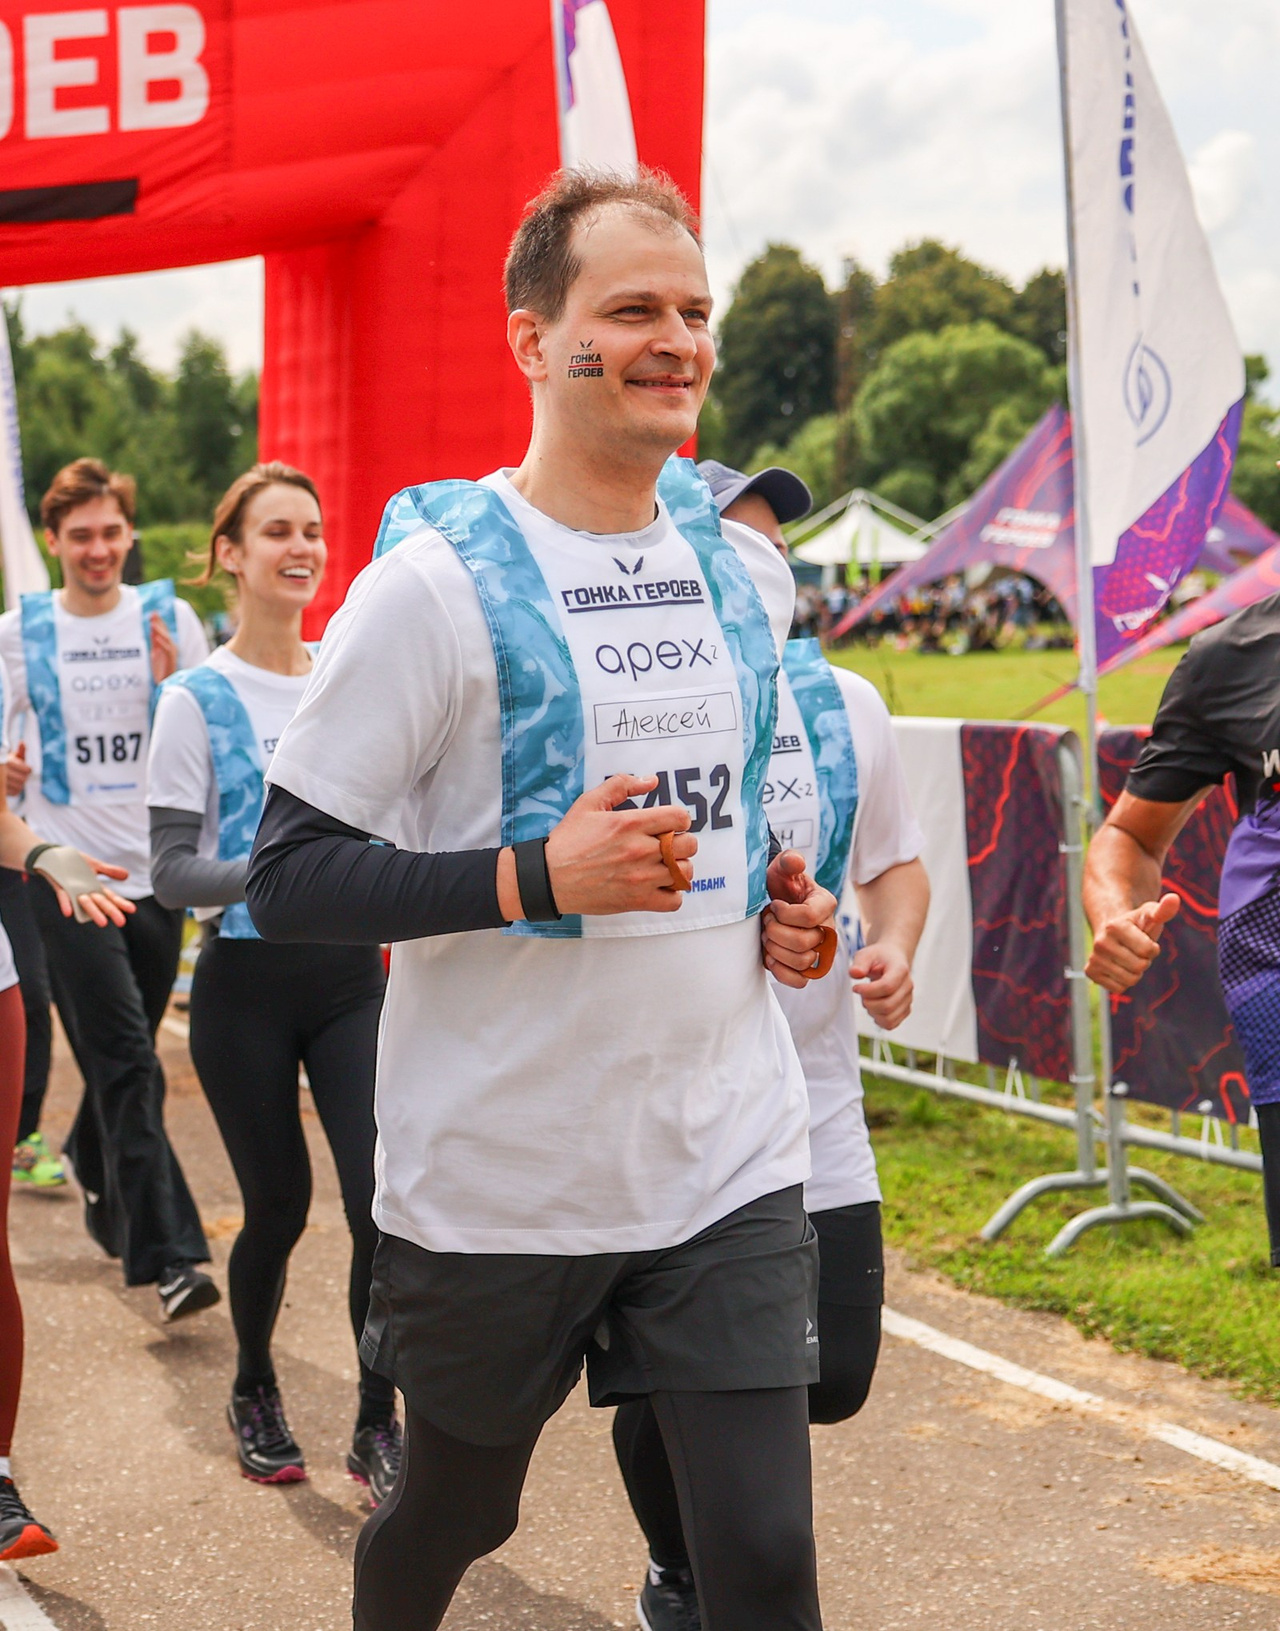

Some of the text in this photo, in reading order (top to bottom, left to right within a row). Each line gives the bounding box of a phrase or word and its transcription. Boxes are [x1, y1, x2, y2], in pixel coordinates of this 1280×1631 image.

[568, 367, 603, 378] ГЕРОЕВ
[570, 353, 602, 364] ГОНКА
[561, 579, 702, 607] ГОНКА ГЕРОЕВ
[612, 699, 712, 739] Алексей
[75, 732, 142, 764] 5187
[605, 763, 733, 833] 452
